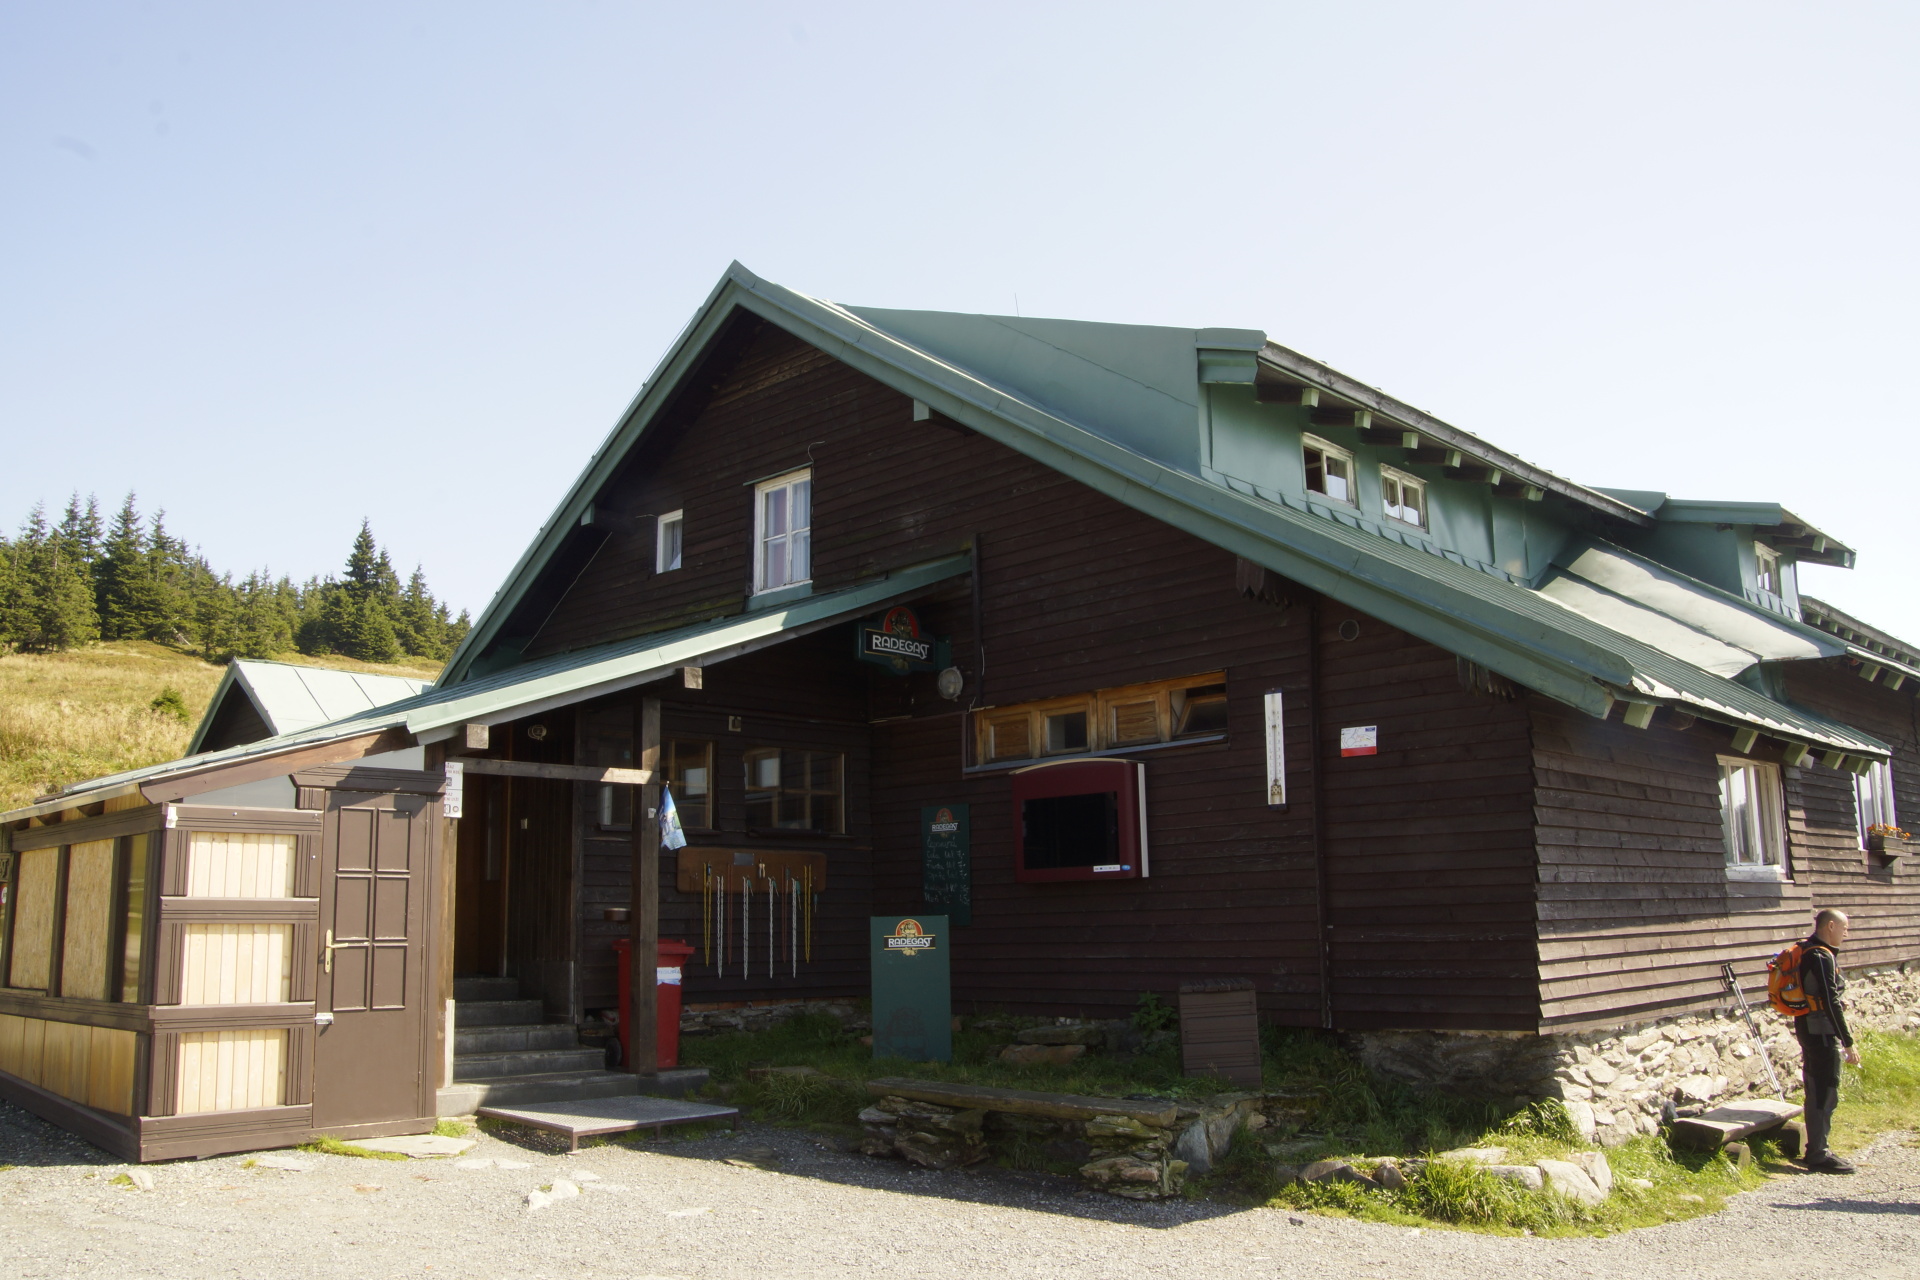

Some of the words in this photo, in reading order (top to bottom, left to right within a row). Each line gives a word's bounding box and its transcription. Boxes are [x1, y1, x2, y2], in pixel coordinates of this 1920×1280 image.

[872, 634, 930, 660] RADEGAST
[931, 822, 959, 832] RADEGAST
[888, 937, 933, 948] RADEGAST
